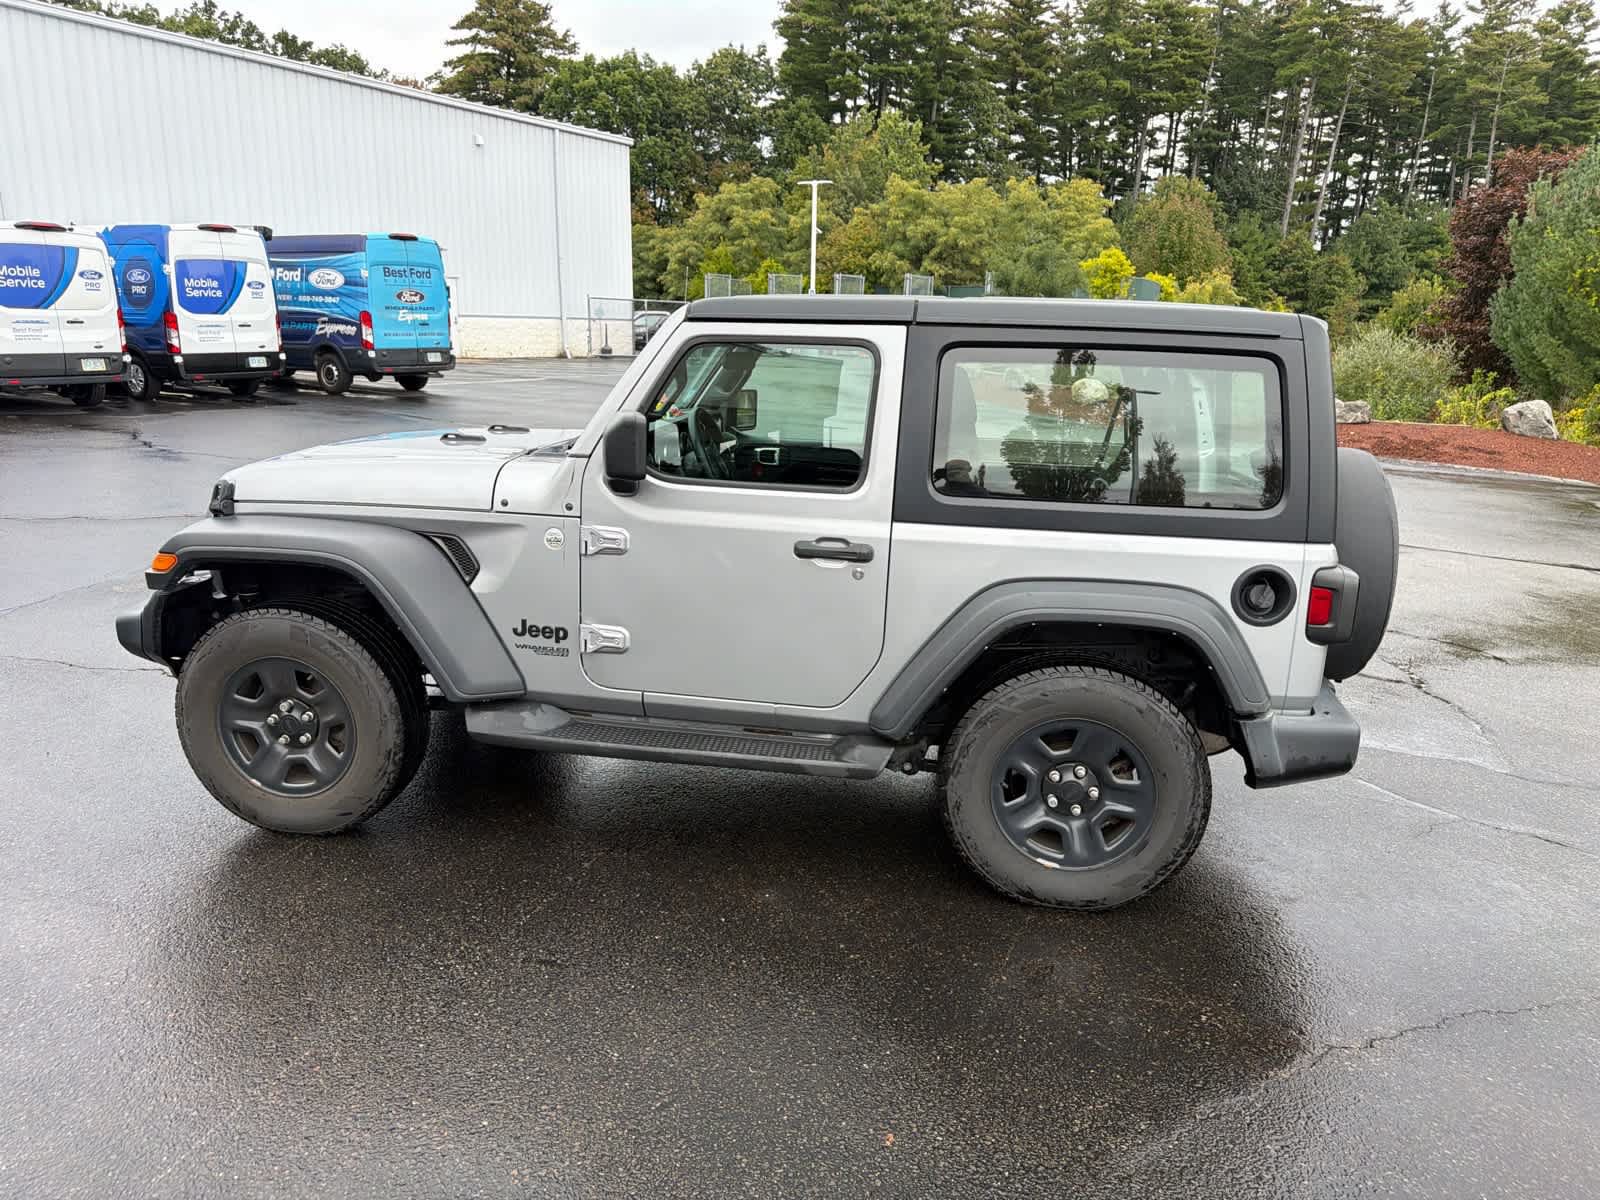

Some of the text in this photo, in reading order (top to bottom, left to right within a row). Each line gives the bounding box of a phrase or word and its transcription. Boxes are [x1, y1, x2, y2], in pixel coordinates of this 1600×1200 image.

[0, 264, 40, 277] Mobile
[276, 267, 301, 281] Ford
[383, 266, 431, 279] Best Ford
[0, 276, 46, 288] Service
[184, 278, 219, 288] Mobile
[131, 285, 146, 294] PRO
[185, 287, 223, 297] Service
[315, 317, 358, 338] Express
[512, 618, 569, 643] Jeep
